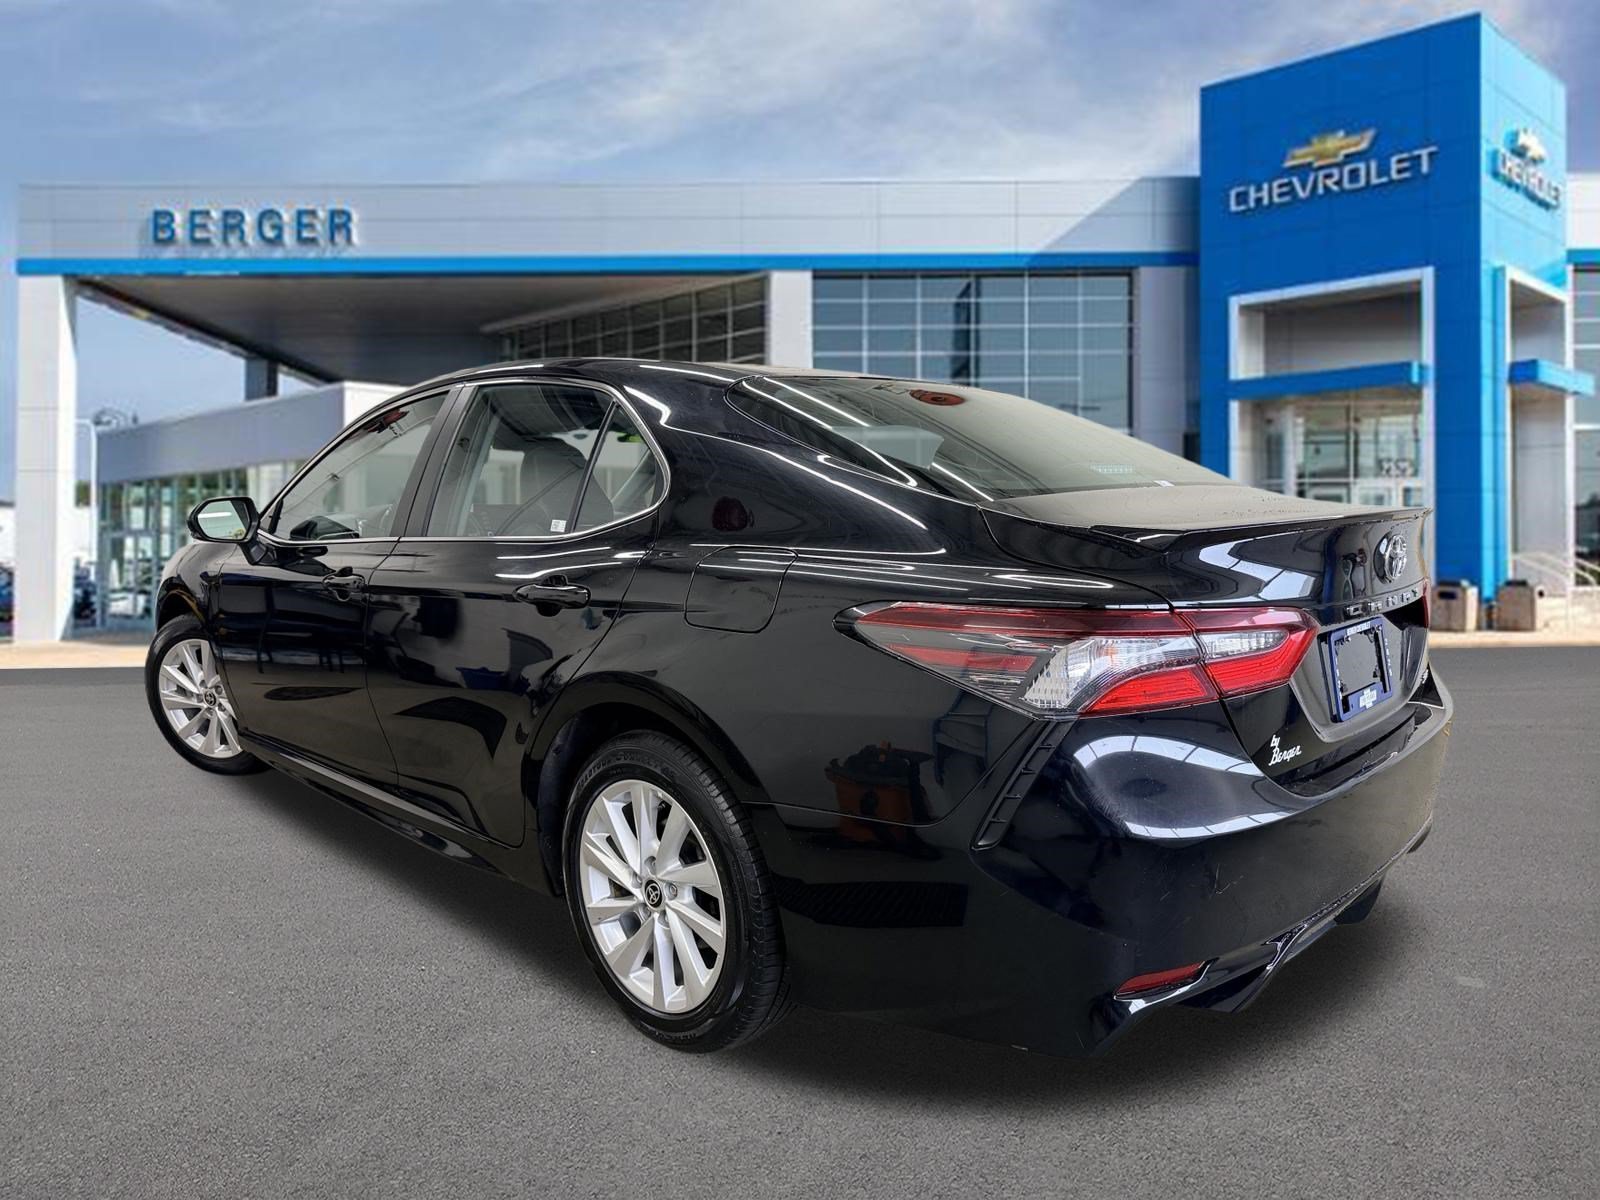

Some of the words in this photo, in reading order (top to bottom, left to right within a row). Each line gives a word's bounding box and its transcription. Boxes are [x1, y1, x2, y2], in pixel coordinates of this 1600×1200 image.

[1229, 146, 1438, 212] CHEVROLET
[152, 207, 356, 246] BERGER
[1268, 745, 1302, 766] Berger
